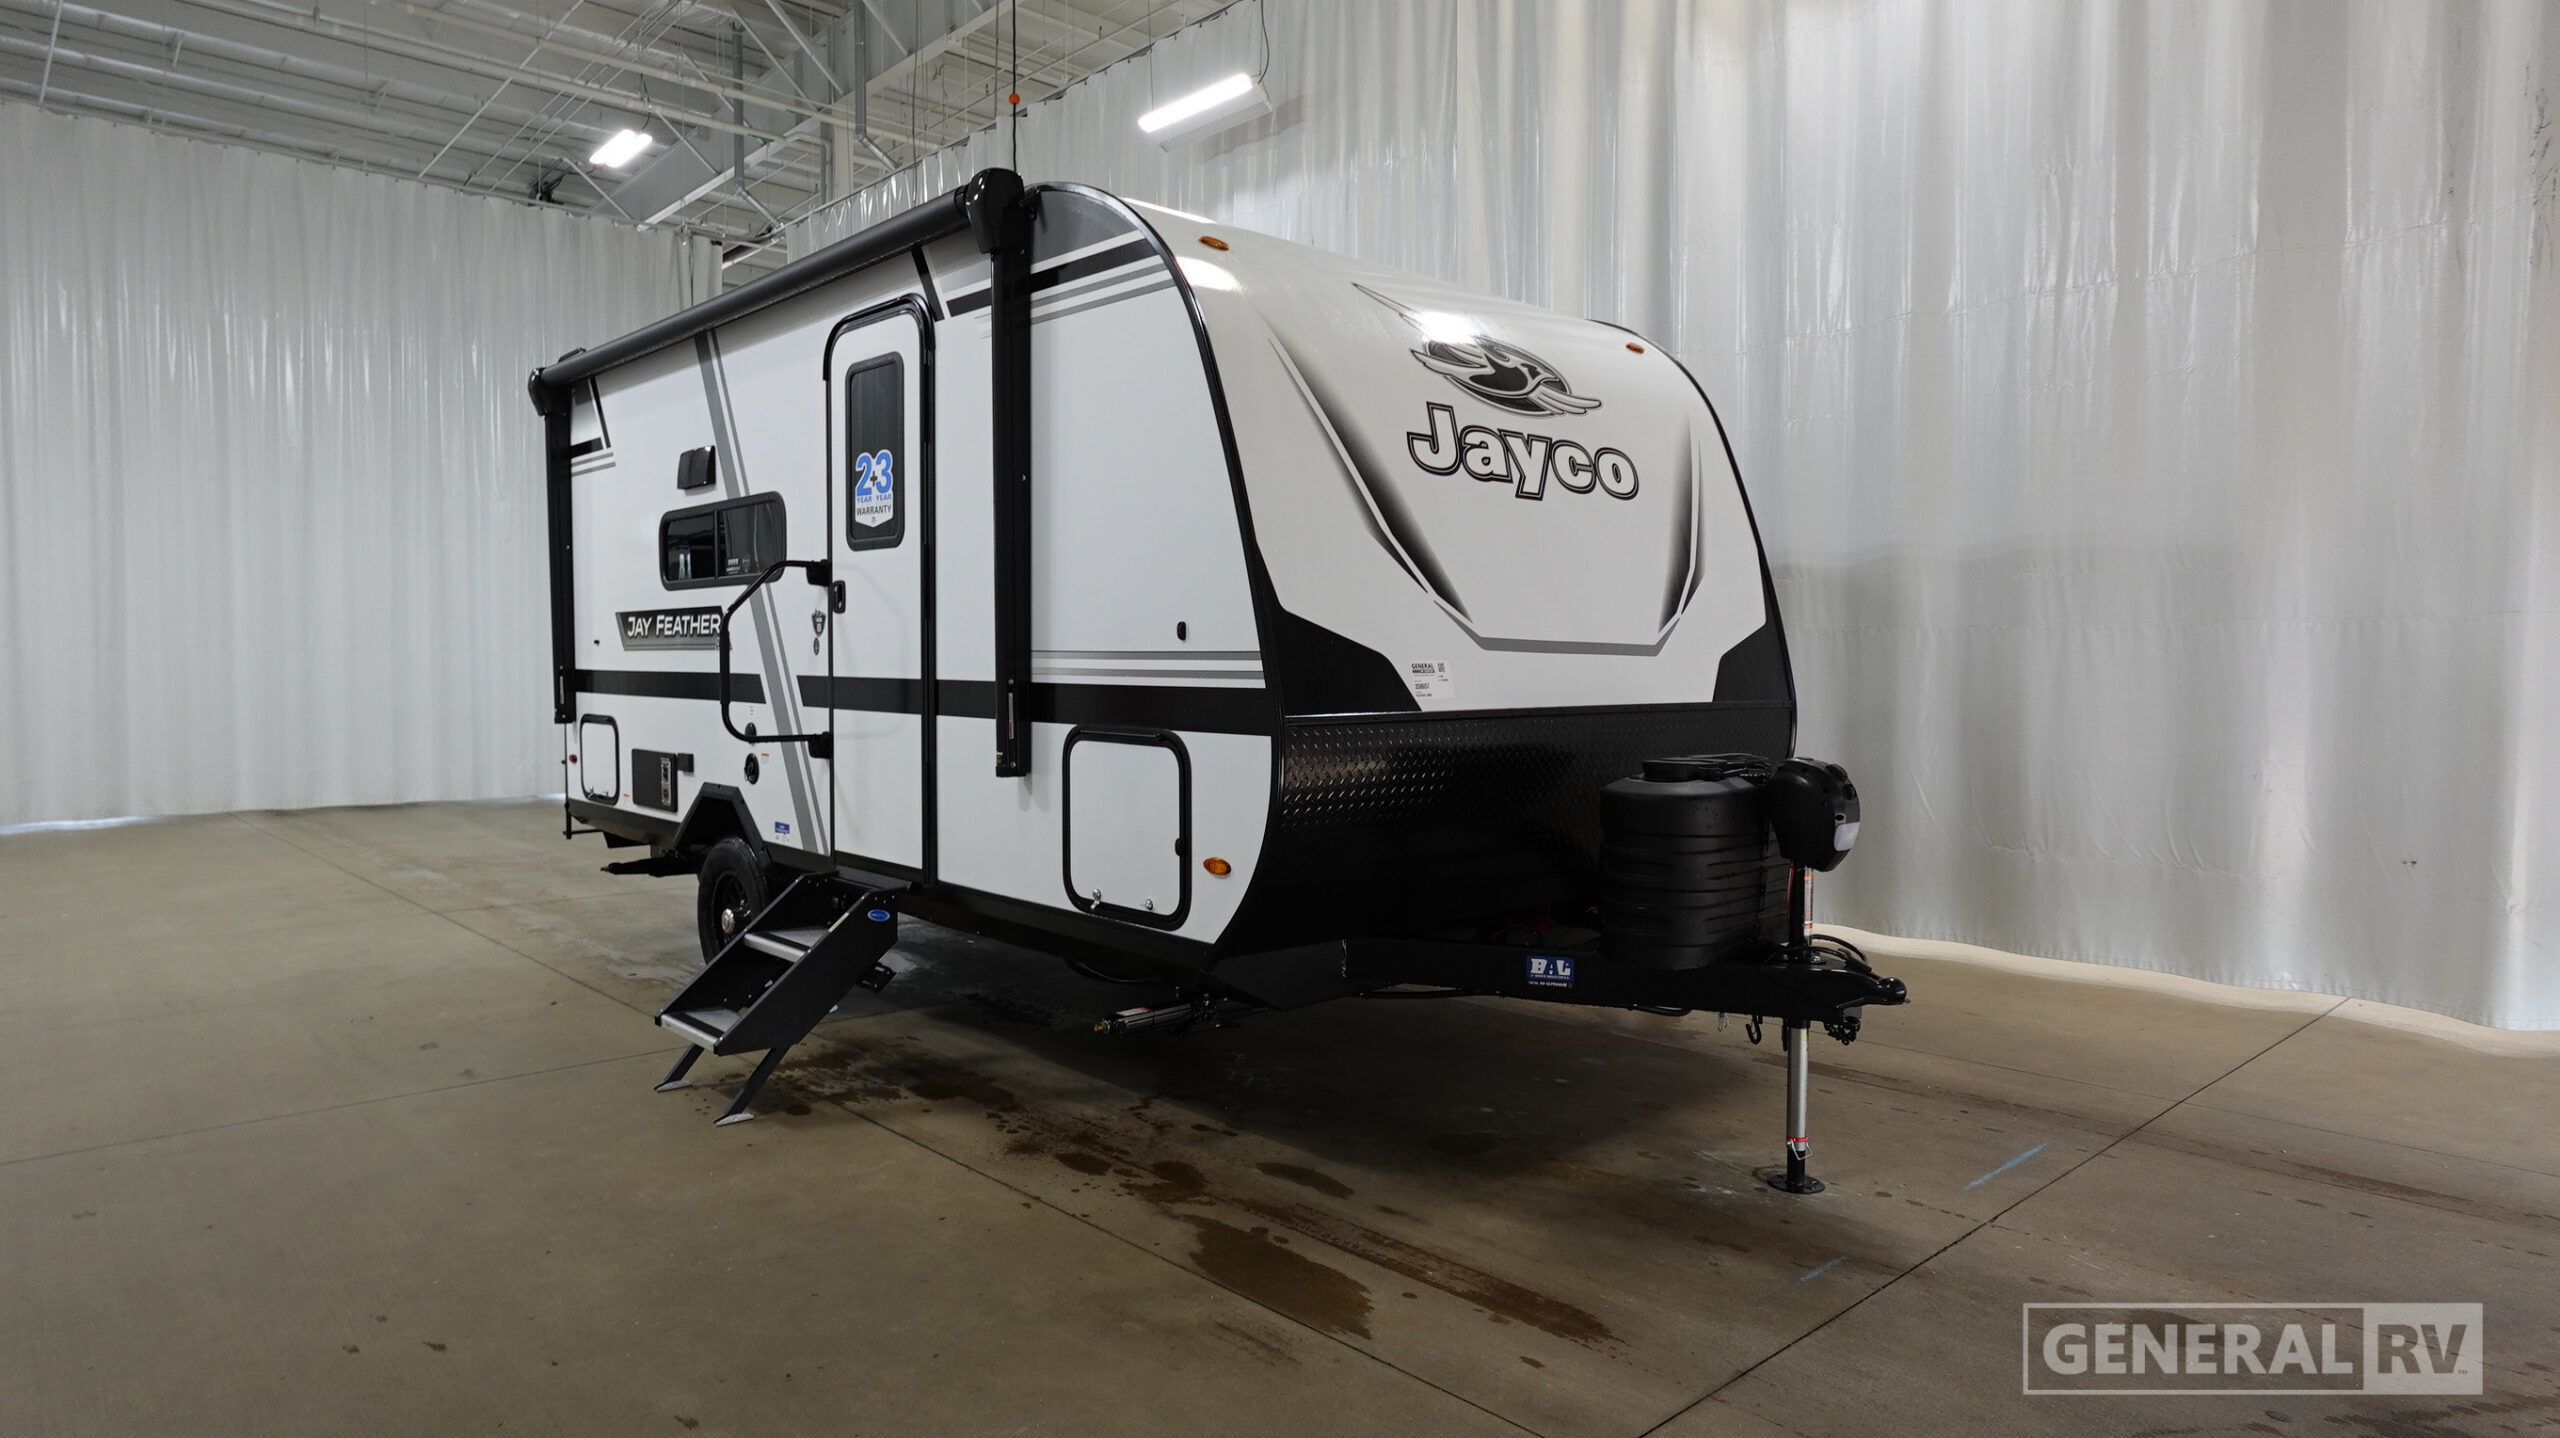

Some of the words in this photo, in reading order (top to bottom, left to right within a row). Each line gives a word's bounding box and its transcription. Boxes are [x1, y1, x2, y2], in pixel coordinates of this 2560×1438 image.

[1406, 401, 1640, 501] Jayco
[857, 496, 872, 504] YEAR
[875, 493, 892, 502] YEAR
[856, 504, 892, 516] WARRANTY
[627, 616, 652, 637] JAY
[655, 614, 721, 636] FEATHER
[1530, 958, 1571, 976] BAL
